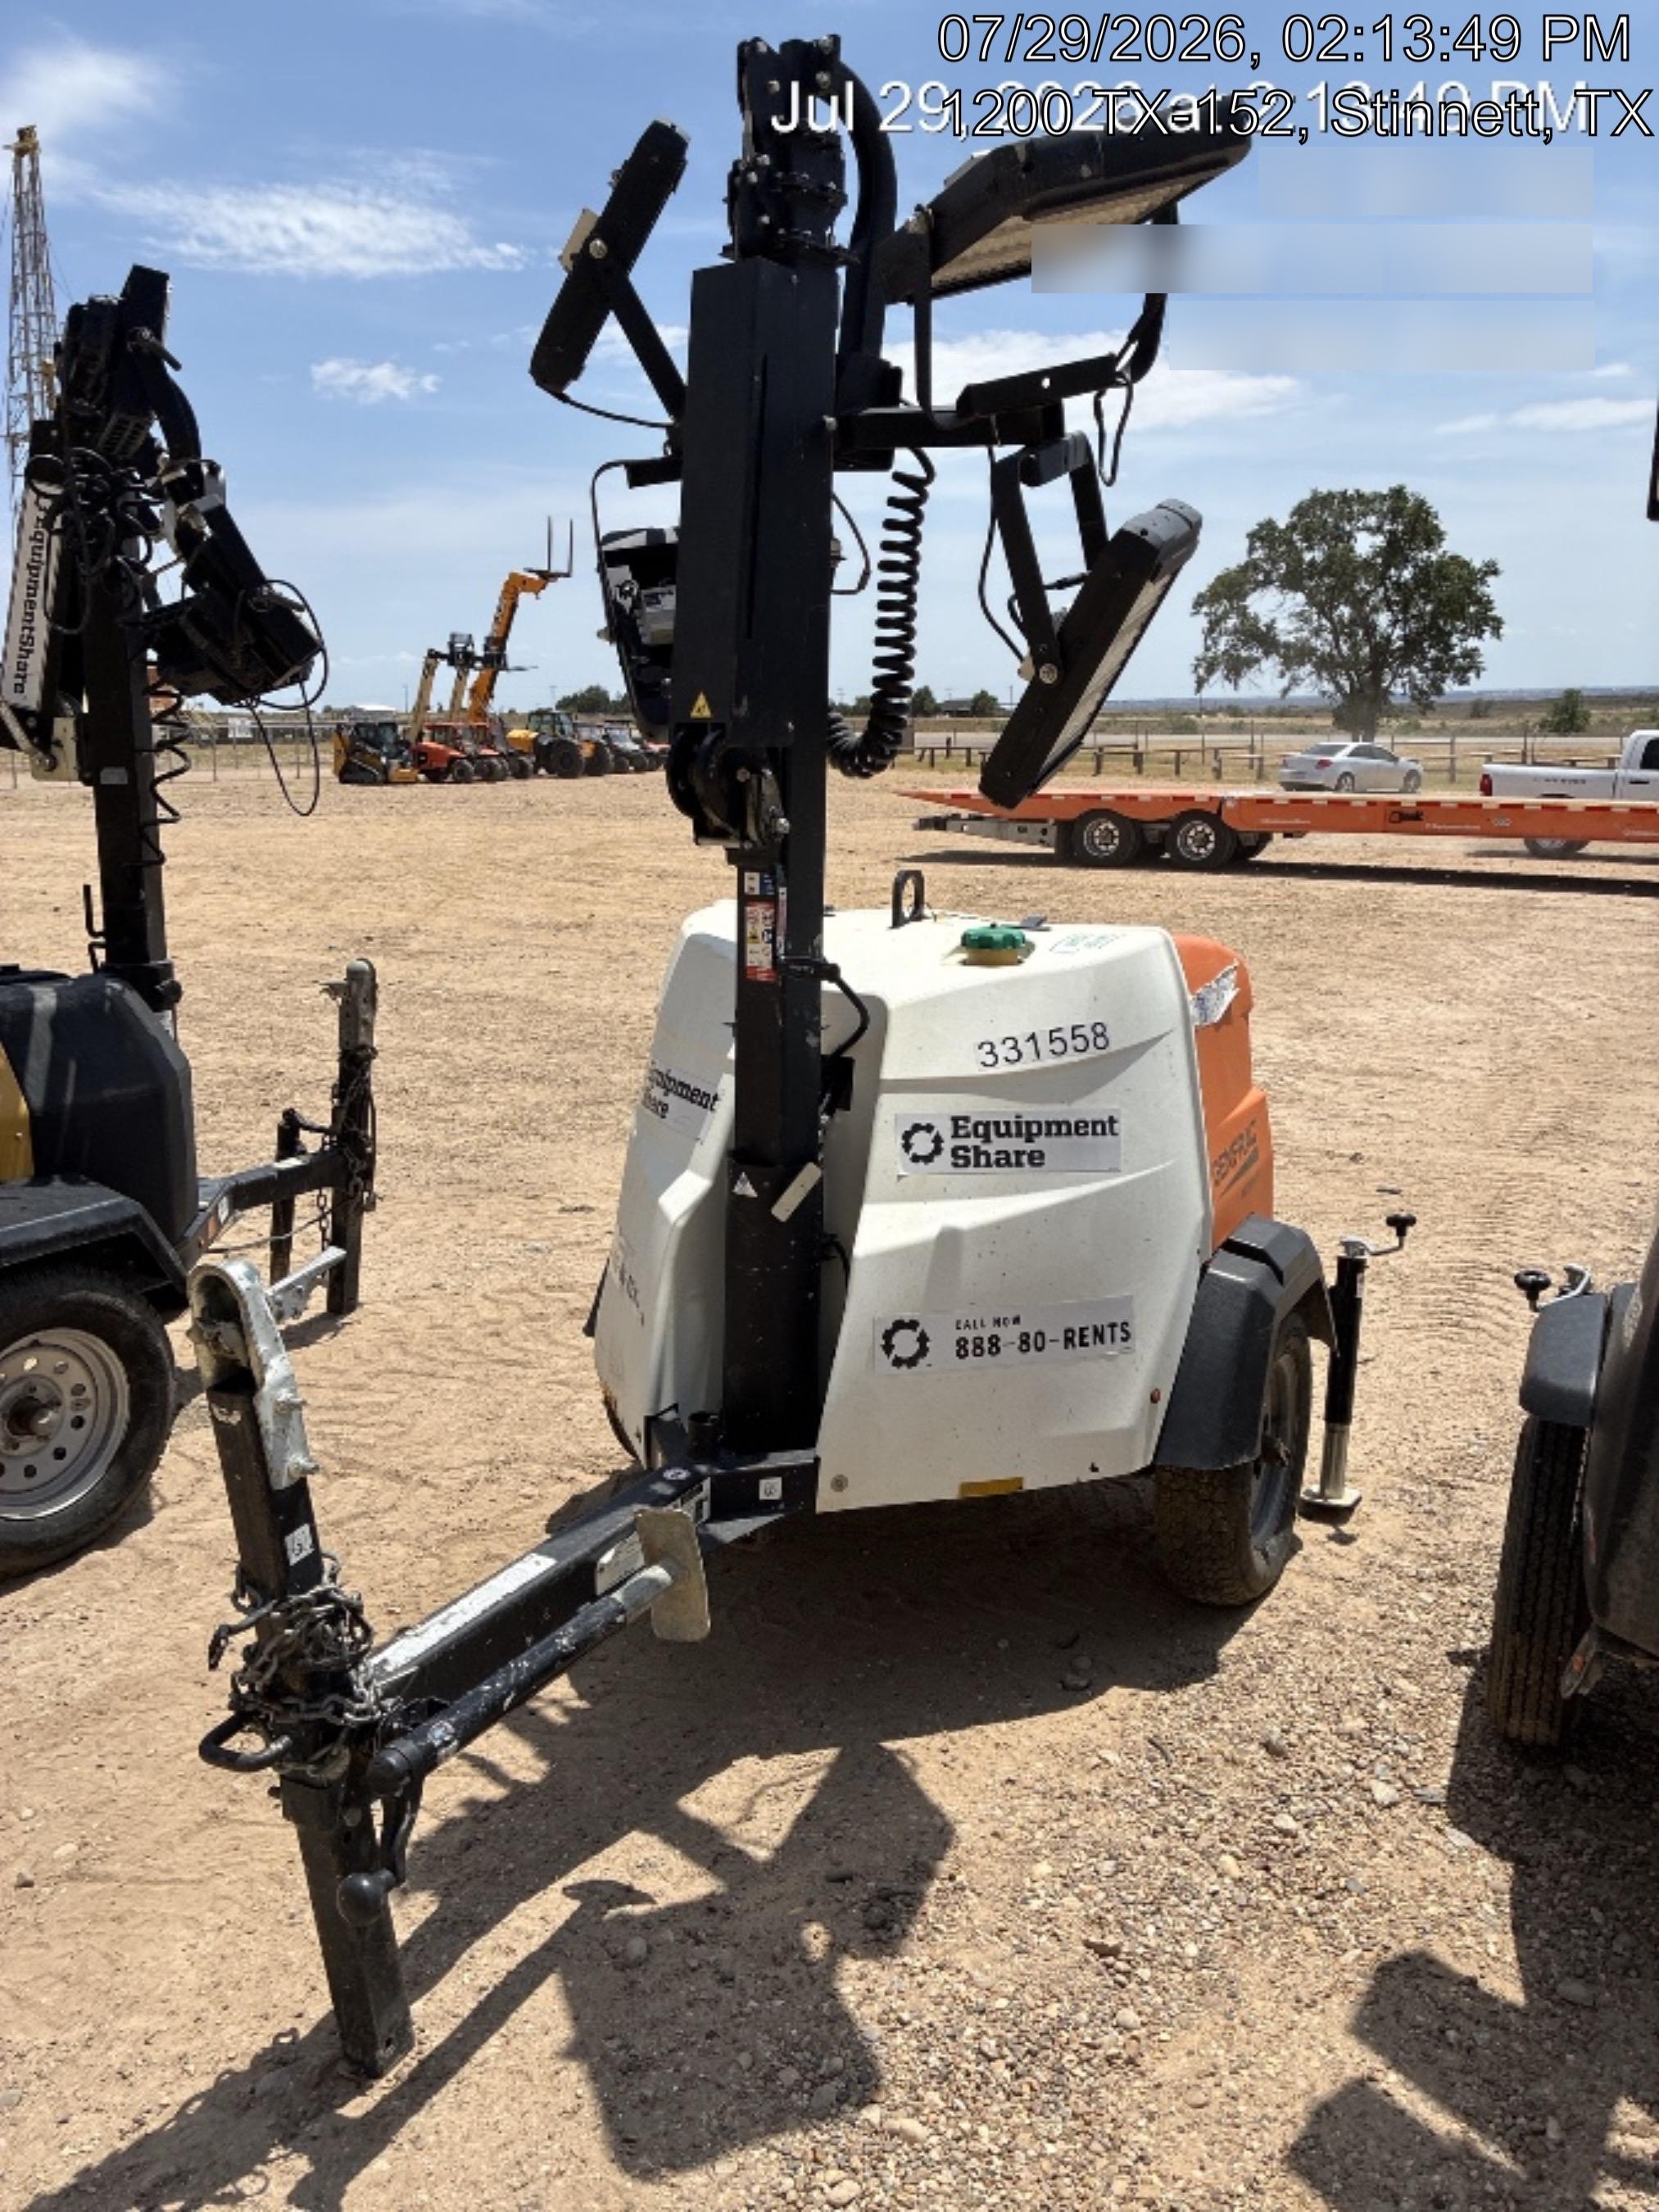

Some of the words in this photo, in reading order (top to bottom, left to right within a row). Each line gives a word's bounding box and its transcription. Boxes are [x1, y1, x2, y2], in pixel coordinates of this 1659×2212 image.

[977, 1022, 1110, 1067] 331558
[950, 1114, 1120, 1144] Equipment
[950, 1145, 1045, 1169] Share
[955, 1318, 986, 1330] CALL
[955, 1321, 1131, 1359] 888-80-RENTS
